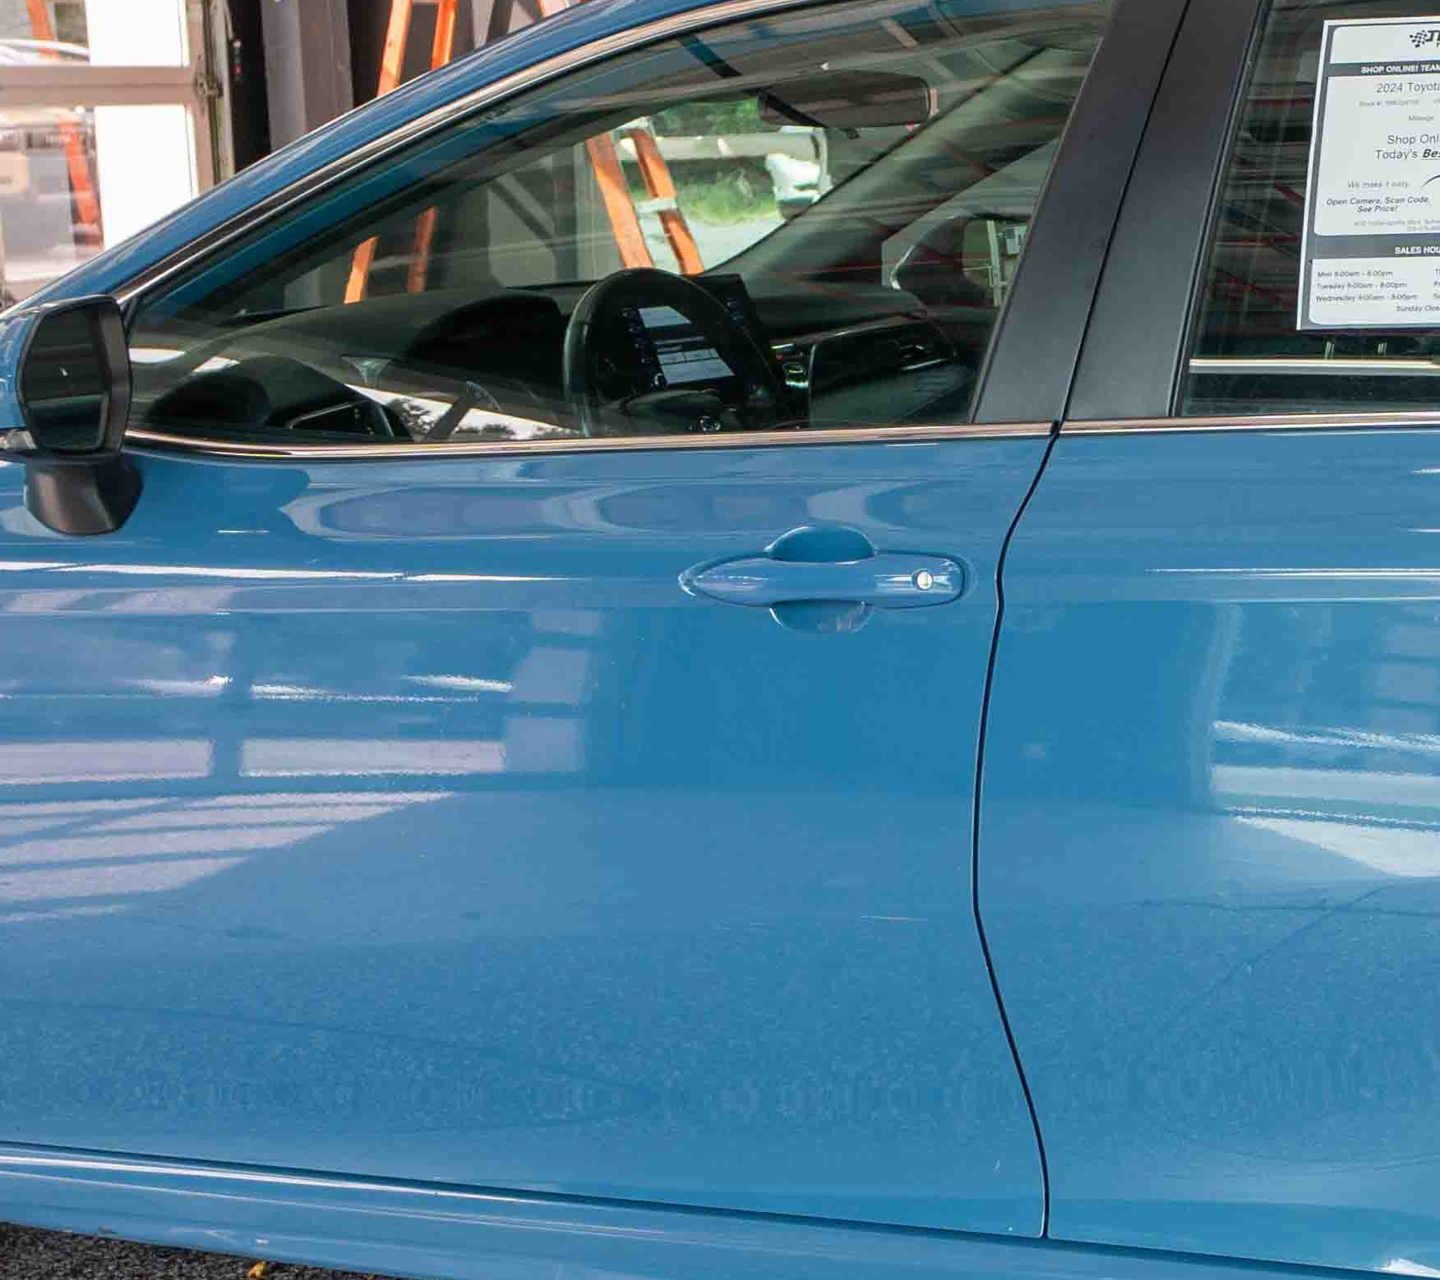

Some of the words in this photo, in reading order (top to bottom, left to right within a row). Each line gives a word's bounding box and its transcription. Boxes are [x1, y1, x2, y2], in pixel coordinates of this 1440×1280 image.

[1361, 65, 1384, 74] SHOP
[1376, 83, 1403, 93] 2024
[1387, 134, 1416, 145] Shop
[1375, 148, 1418, 160] Today's
[1326, 197, 1348, 206] Open
[1384, 196, 1407, 205] Scan
[1357, 204, 1374, 213] See
[1394, 246, 1422, 255] SALES
[1396, 304, 1423, 313] Sunday
